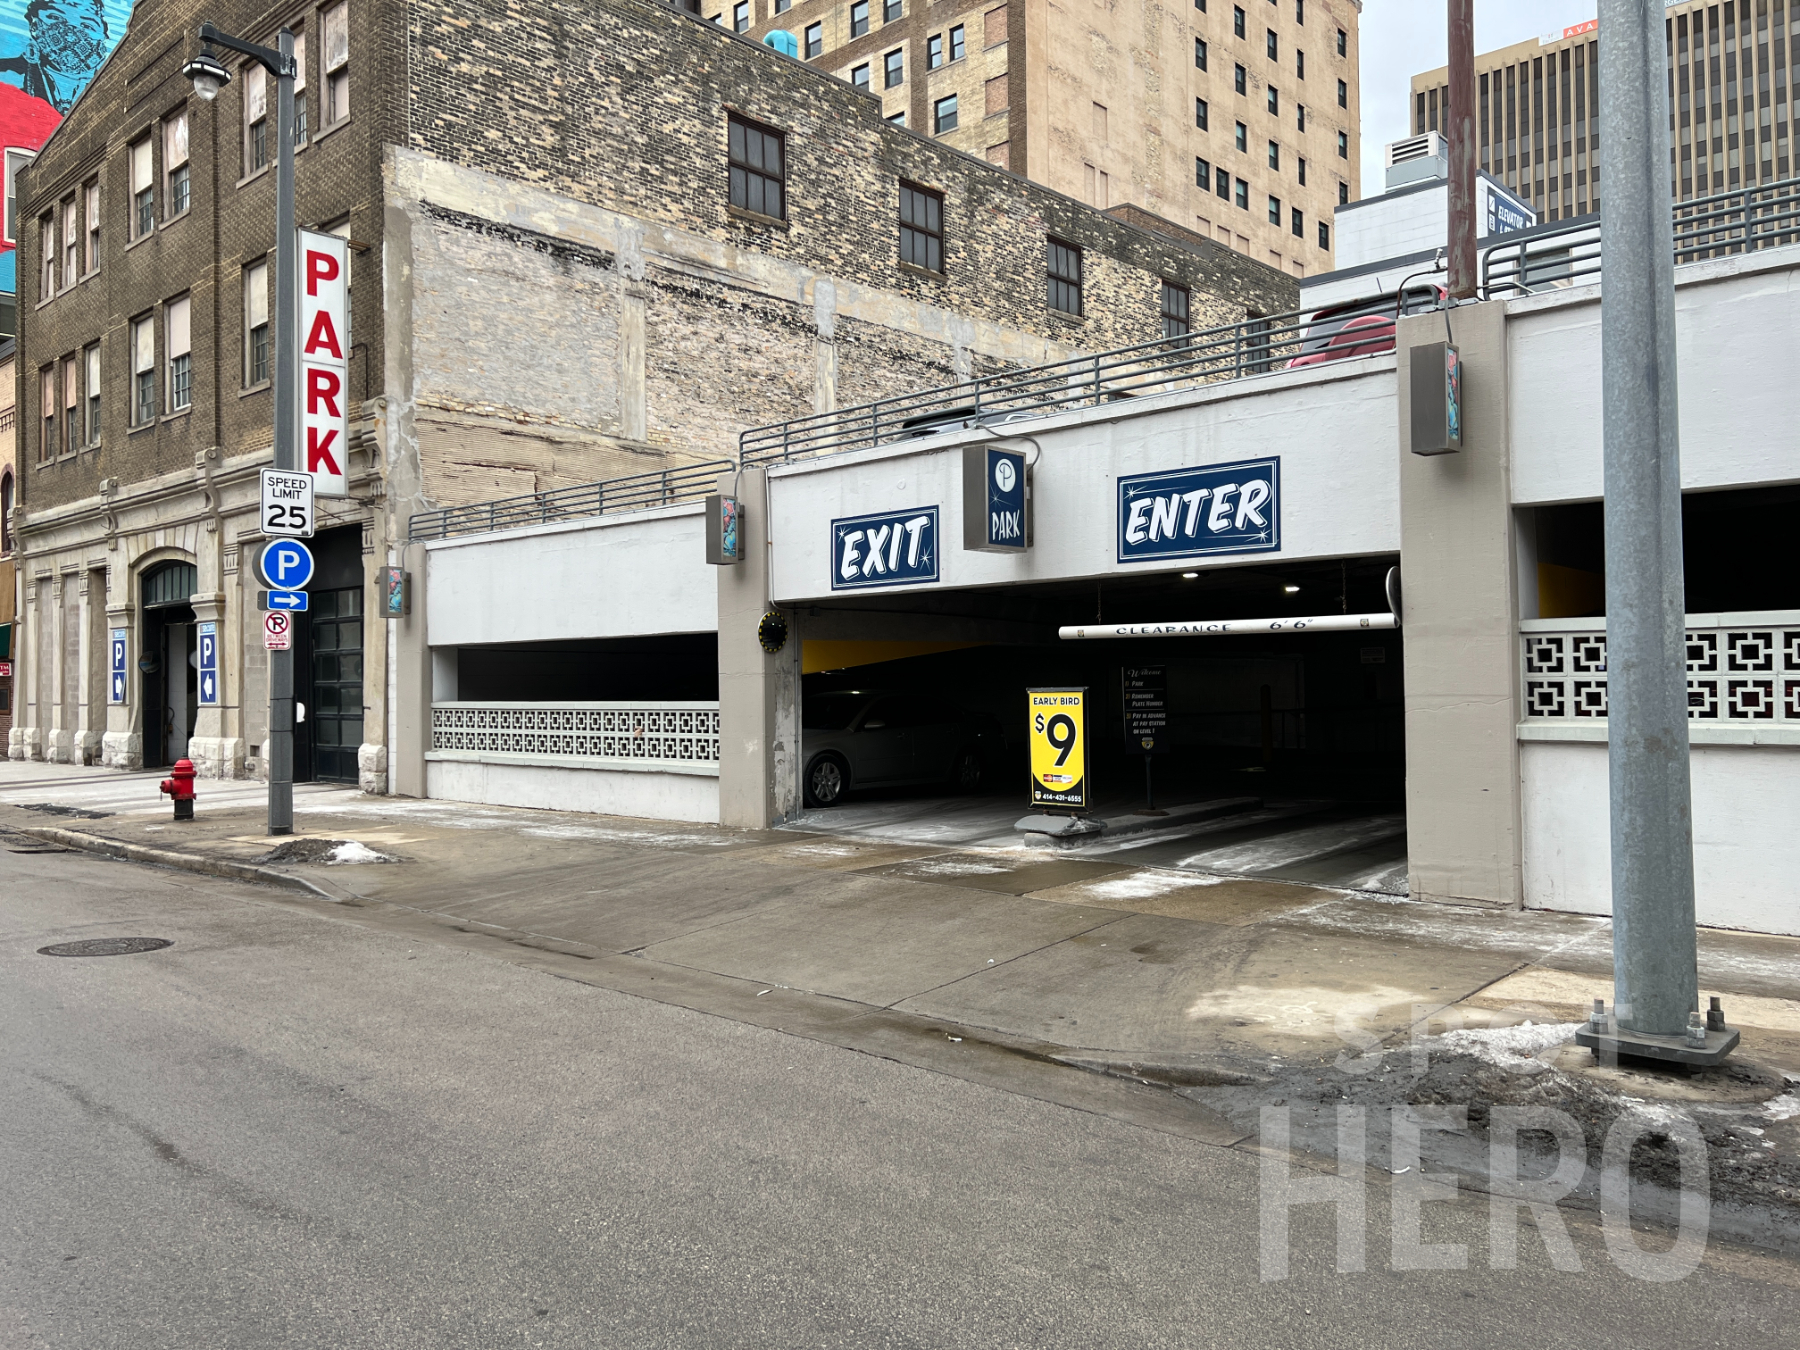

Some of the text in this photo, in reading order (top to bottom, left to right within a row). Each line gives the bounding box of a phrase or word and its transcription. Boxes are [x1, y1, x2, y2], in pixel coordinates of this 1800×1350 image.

[1498, 205, 1524, 230] ELEVATOR
[304, 249, 343, 476] PARK
[267, 476, 307, 490] SPEED
[272, 488, 303, 500] LIMIT
[267, 504, 307, 529] 25
[992, 509, 1021, 541] PARK
[1126, 479, 1272, 546] ENTER
[840, 515, 931, 581] EXIT
[278, 550, 300, 580] P
[1116, 623, 1232, 635] CLEARANCE
[115, 643, 123, 667] P
[203, 638, 212, 664] P
[1127, 669, 1162, 678] Welcome
[1033, 697, 1080, 706] EARLY BIRD
